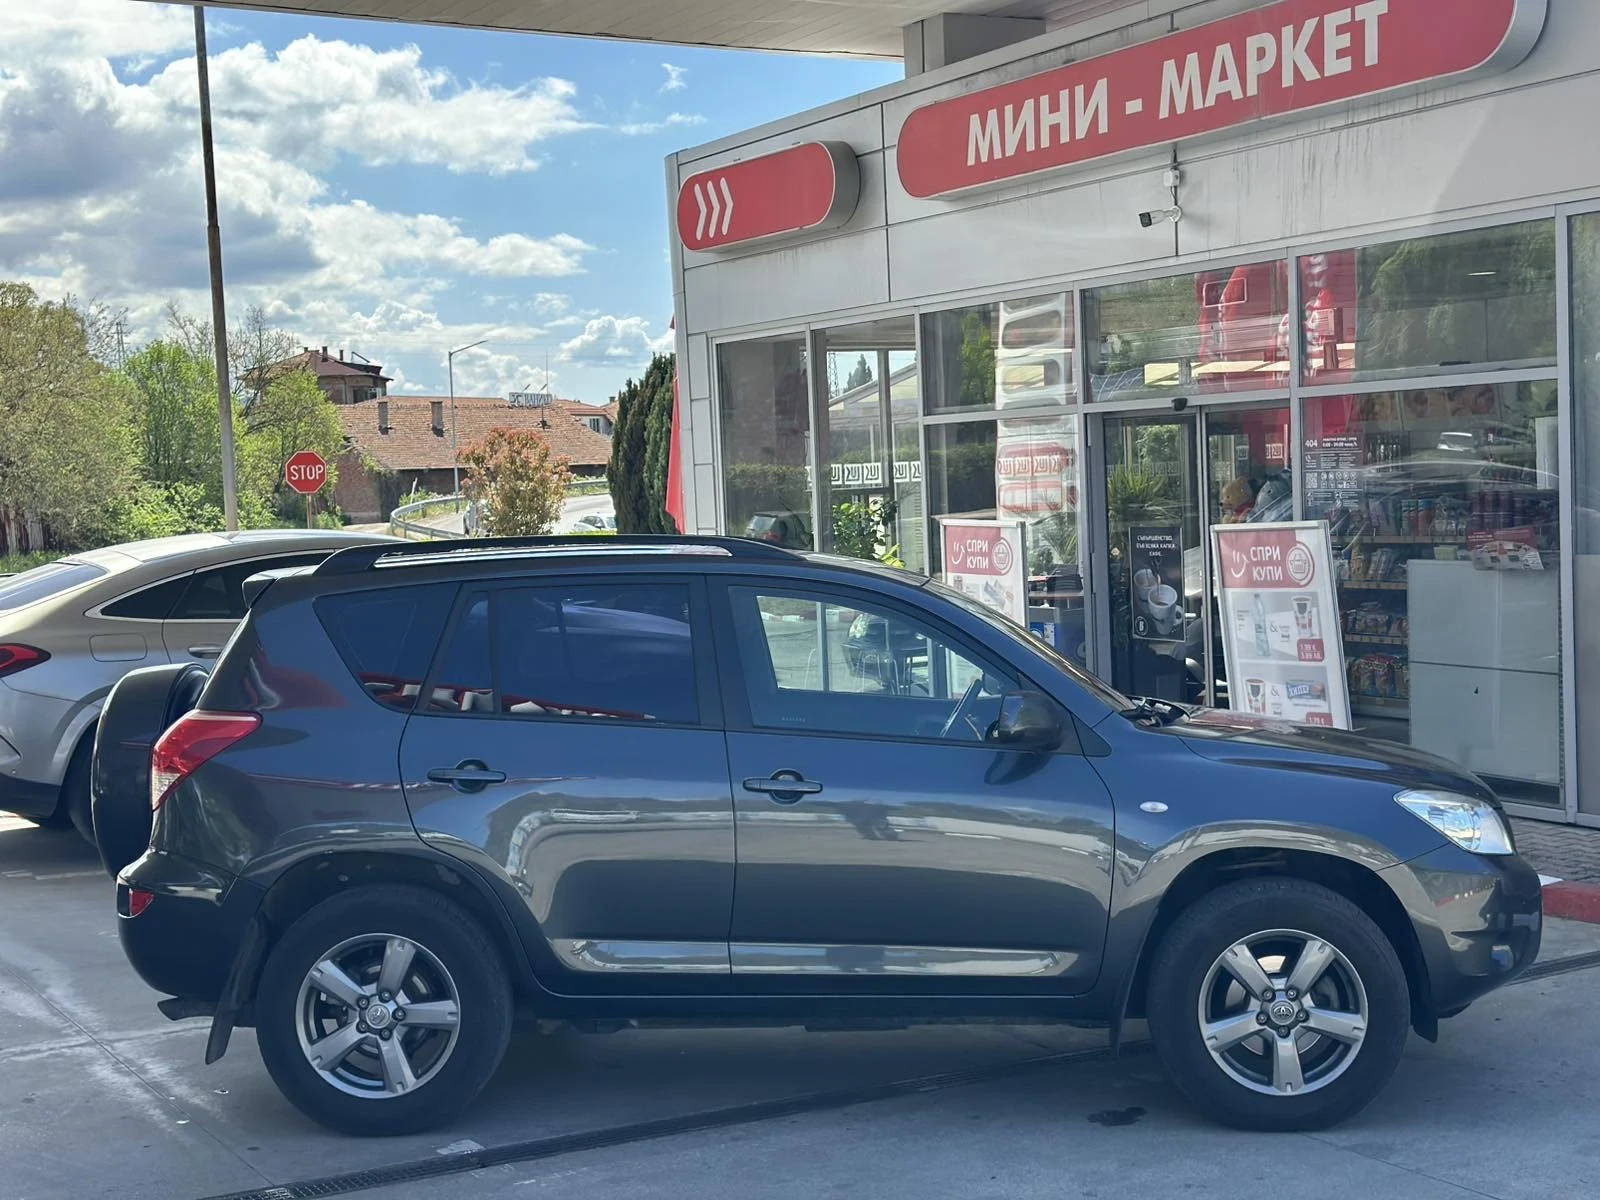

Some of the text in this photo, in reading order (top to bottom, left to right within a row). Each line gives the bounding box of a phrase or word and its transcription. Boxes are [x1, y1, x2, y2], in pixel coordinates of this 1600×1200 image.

[966, 77, 1109, 166] МИНИ
[1158, 0, 1389, 119] МАРКЕТ
[1305, 439, 1318, 448] 404
[290, 464, 324, 481] STOP
[966, 539, 989, 553] СПРИ
[1250, 545, 1281, 561] СПРИ
[966, 555, 989, 569] КУПИ
[1252, 565, 1284, 581] КУПИ
